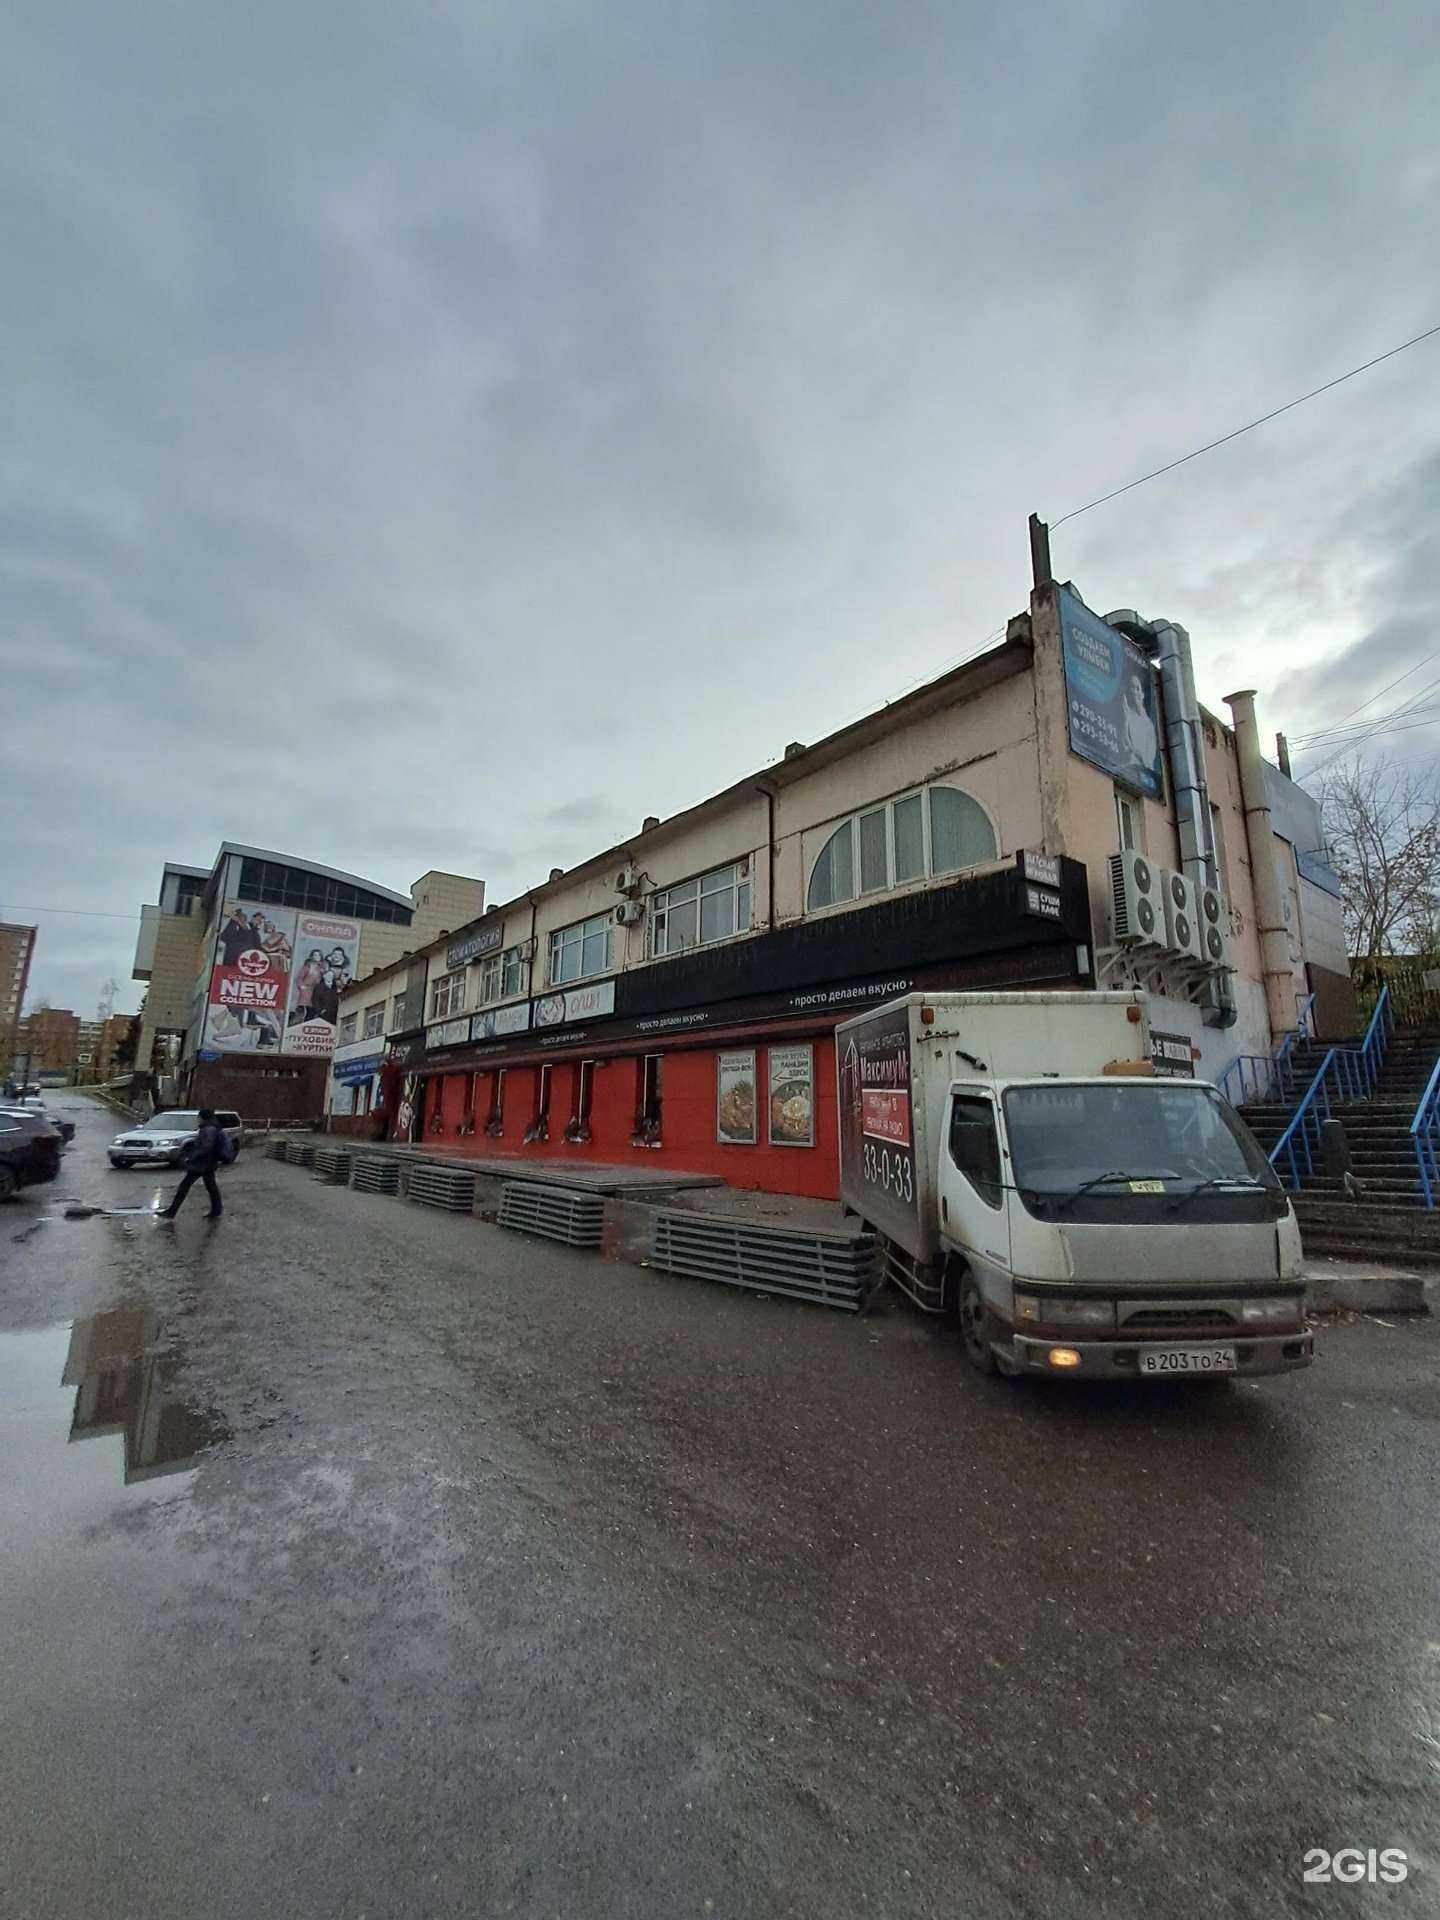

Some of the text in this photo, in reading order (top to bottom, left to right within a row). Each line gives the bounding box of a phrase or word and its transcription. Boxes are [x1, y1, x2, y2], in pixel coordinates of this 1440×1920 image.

[220, 979, 280, 1000] NEW
[795, 979, 907, 1008] просто делаем вкусно
[219, 996, 277, 1008] COLLECTION
[288, 1035, 336, 1045] ПУХОВИК
[864, 1143, 912, 1203] 33-0-33
